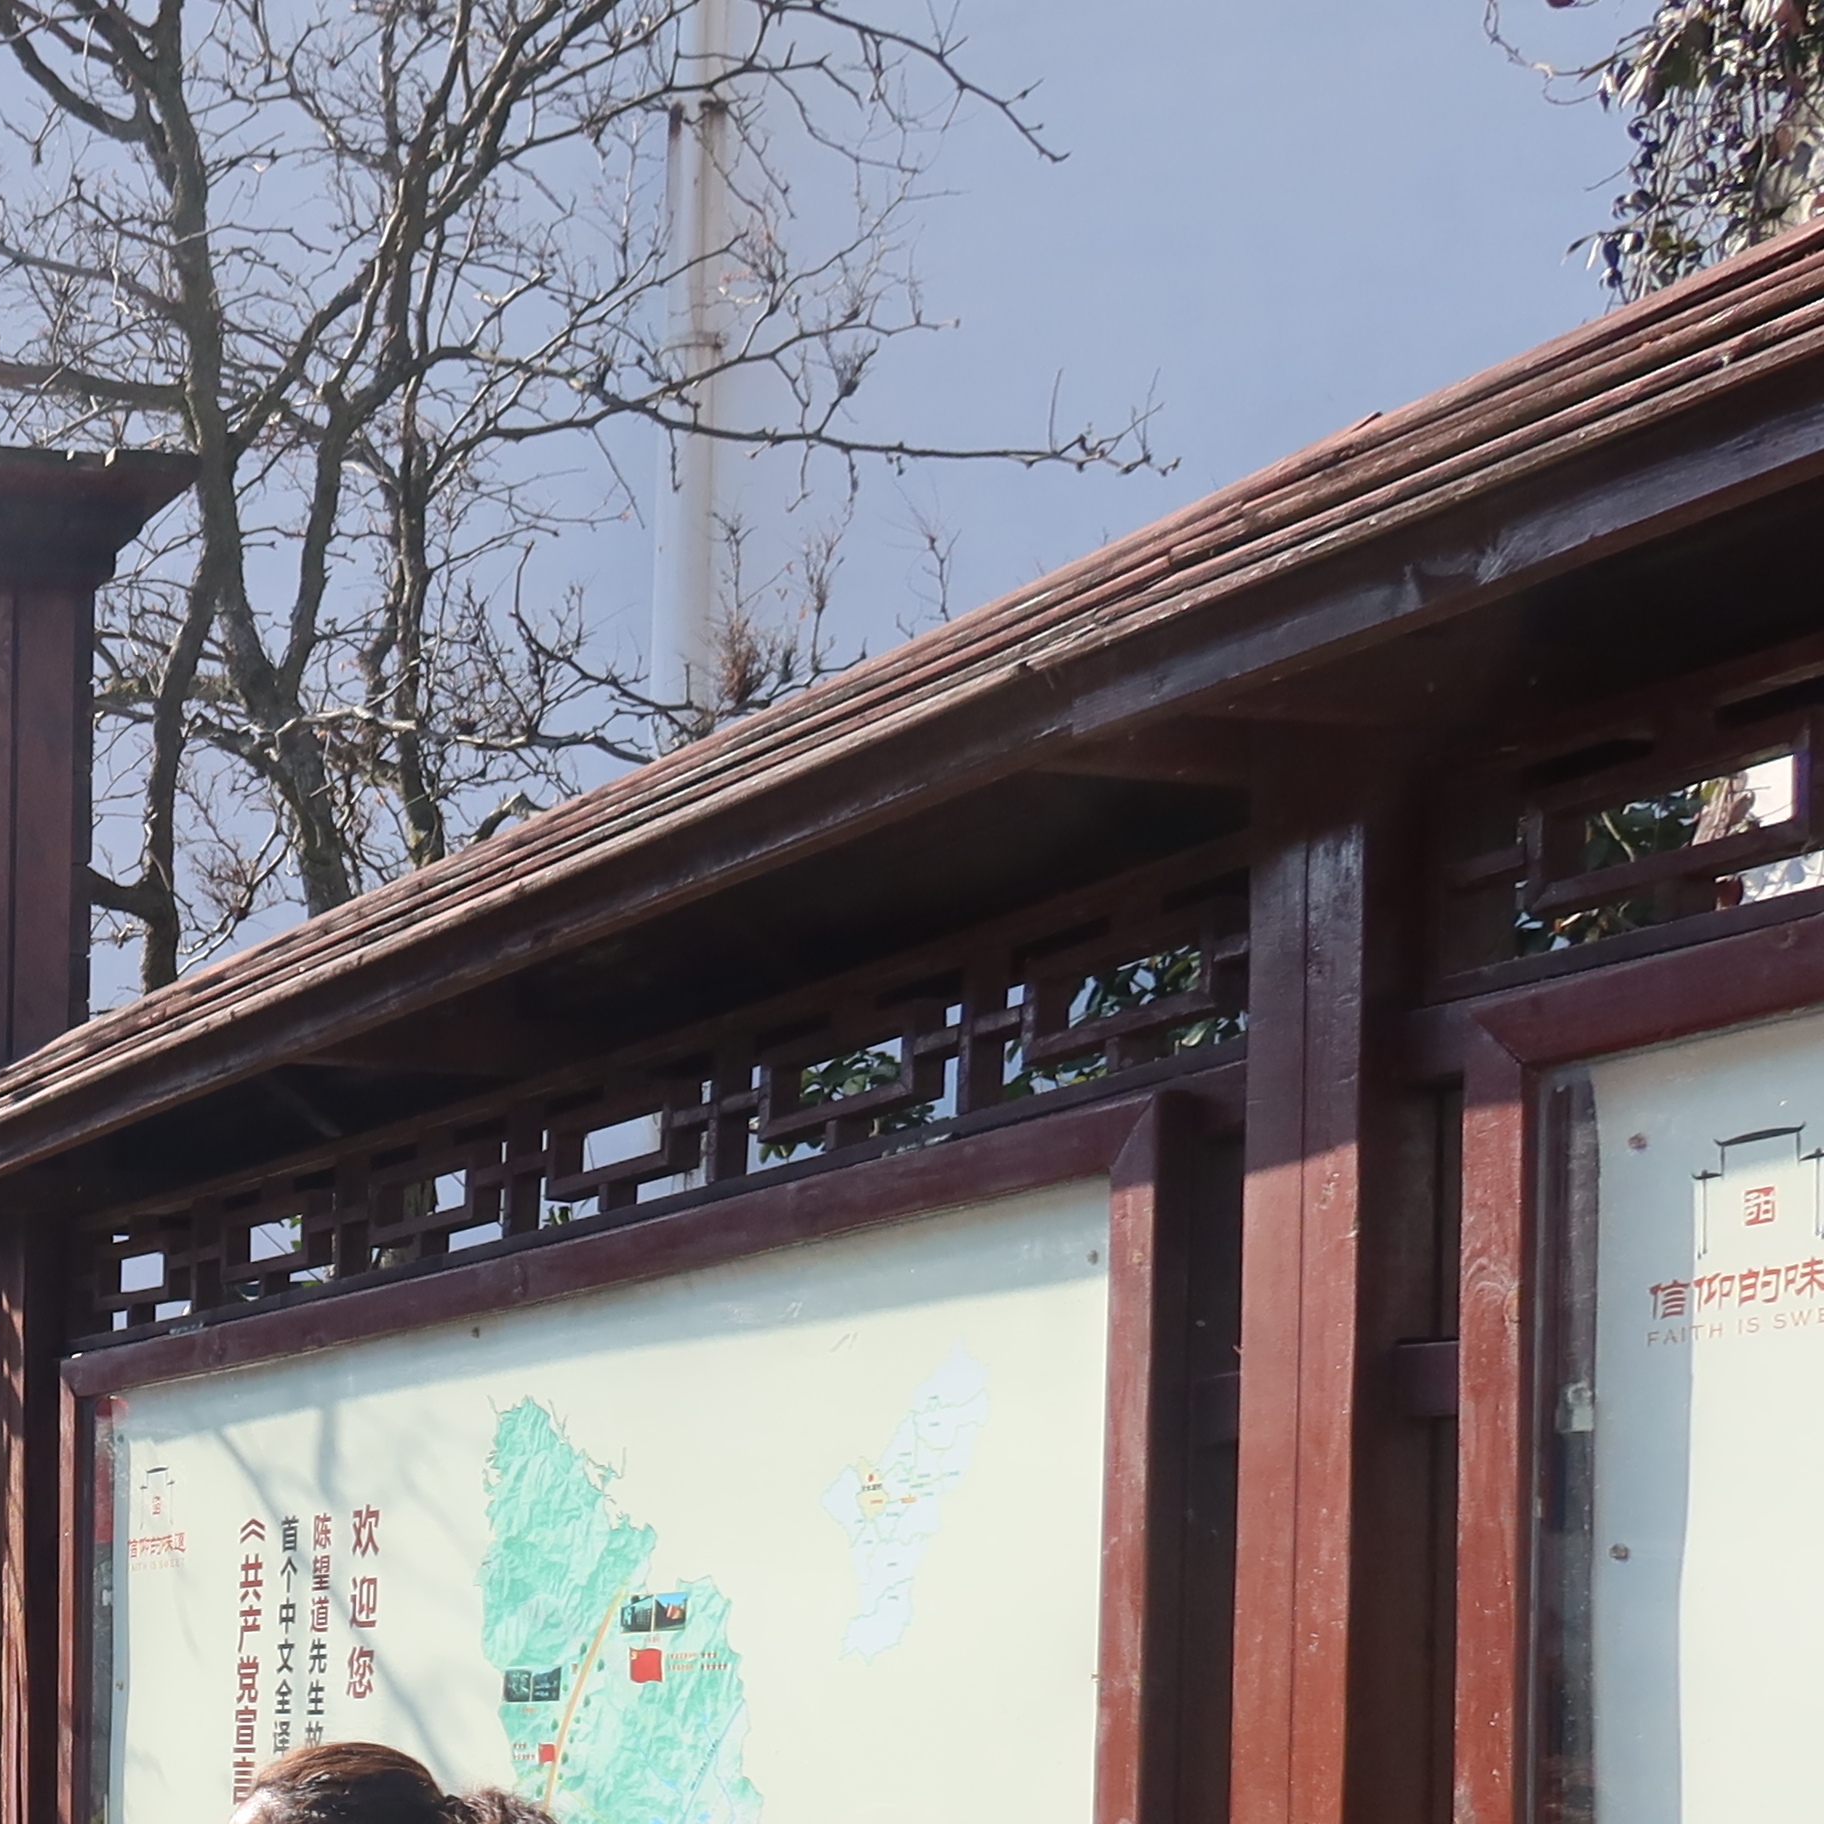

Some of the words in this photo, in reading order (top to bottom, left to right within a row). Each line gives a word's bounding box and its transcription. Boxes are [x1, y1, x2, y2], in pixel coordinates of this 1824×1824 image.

[1646, 1322, 1723, 1347] FAITH
[1738, 1317, 1760, 1335] IS
[128, 1532, 187, 1558] 信仰的味道
[345, 1503, 382, 1699] 欢迎您
